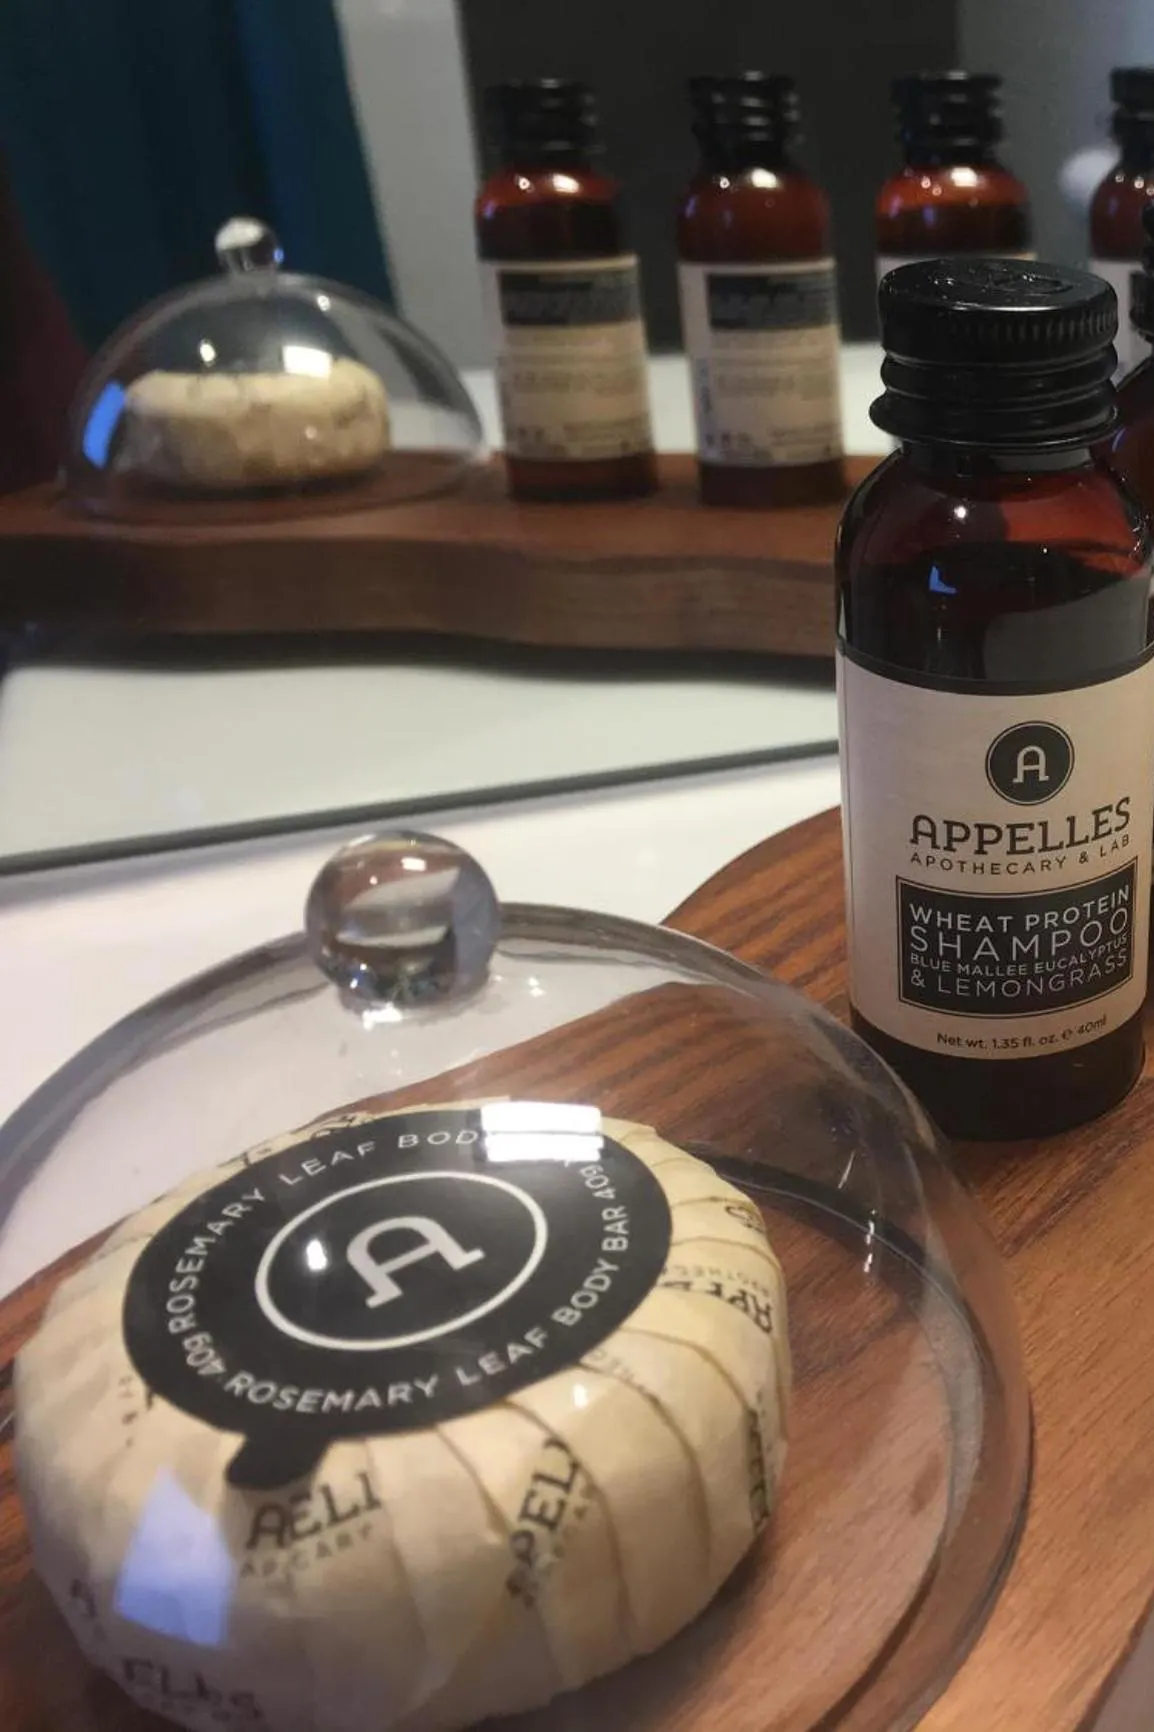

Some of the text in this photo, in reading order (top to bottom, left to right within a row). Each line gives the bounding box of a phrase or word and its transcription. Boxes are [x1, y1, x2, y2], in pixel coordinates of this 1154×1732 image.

[1012, 745, 1050, 785] A
[910, 797, 1131, 856] APPELLES
[910, 835, 1131, 877] APOTHECARY & LAB
[909, 884, 1130, 934] WHEAT PROTEIN
[909, 907, 1129, 961] SHAMPOO
[910, 934, 1129, 977] BLUE MALLEE EUCALYPTUS
[910, 948, 1128, 998] & LEMONGRASS
[936, 1031, 963, 1047] Net
[991, 1038, 1020, 1050] 1.35
[1038, 1034, 1058, 1047] oz.
[1077, 1014, 1108, 1036] 40ml
[166, 1187, 266, 1335] ROSEMARY
[278, 1140, 376, 1186] LEAF
[397, 1129, 479, 1149] BOD
[346, 1215, 486, 1309] A
[224, 1370, 439, 1415] ROSEMARY
[455, 1326, 549, 1387] LEAF
[551, 1257, 621, 1327] BODY
[601, 1204, 630, 1252] BAR
